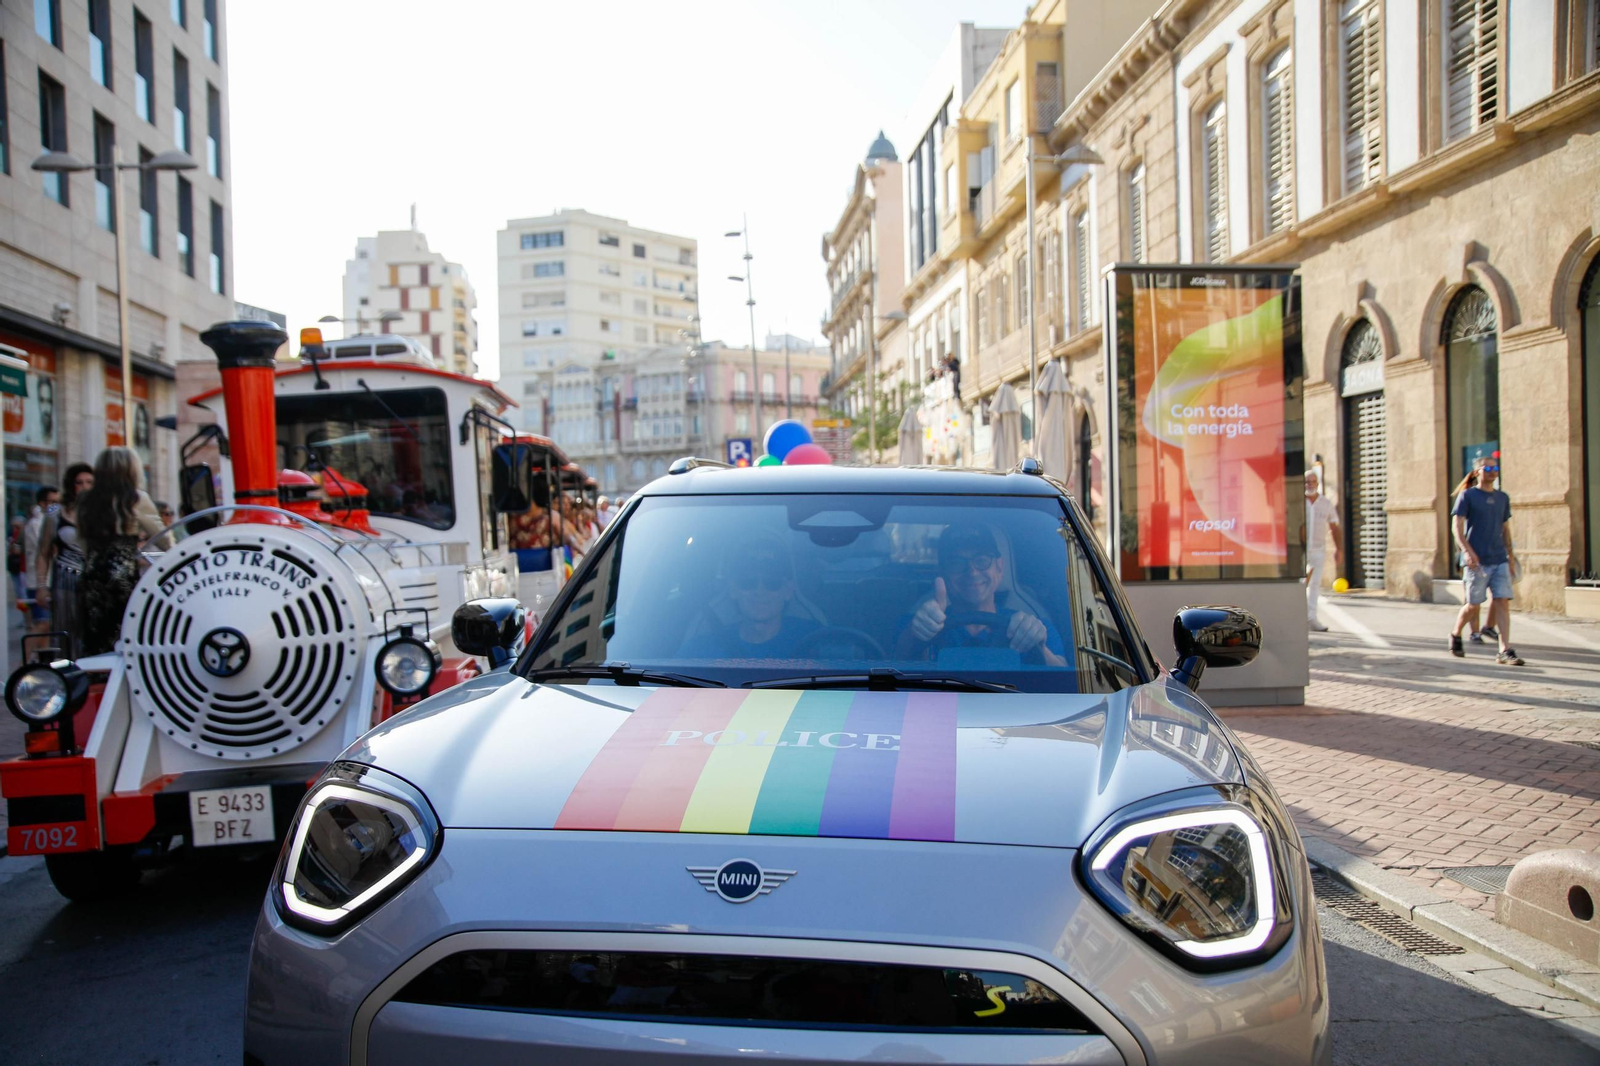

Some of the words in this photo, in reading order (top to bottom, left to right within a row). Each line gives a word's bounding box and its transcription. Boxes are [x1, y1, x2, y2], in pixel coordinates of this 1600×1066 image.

[1171, 404, 1205, 418] Con
[1208, 403, 1249, 418] toda
[1167, 421, 1184, 435] la
[1187, 419, 1253, 438] energía
[1189, 517, 1236, 533] repsol
[160, 552, 228, 597] DOTTO
[239, 551, 312, 589] TRAINS
[177, 571, 280, 604] CASTELFRANCO
[212, 587, 251, 599] ITALY
[658, 730, 901, 751] POLICE
[198, 797, 208, 815] E
[218, 793, 265, 813] 9433
[21, 826, 78, 850] 7092
[214, 819, 252, 839] BFZ
[721, 872, 758, 886] MINI
